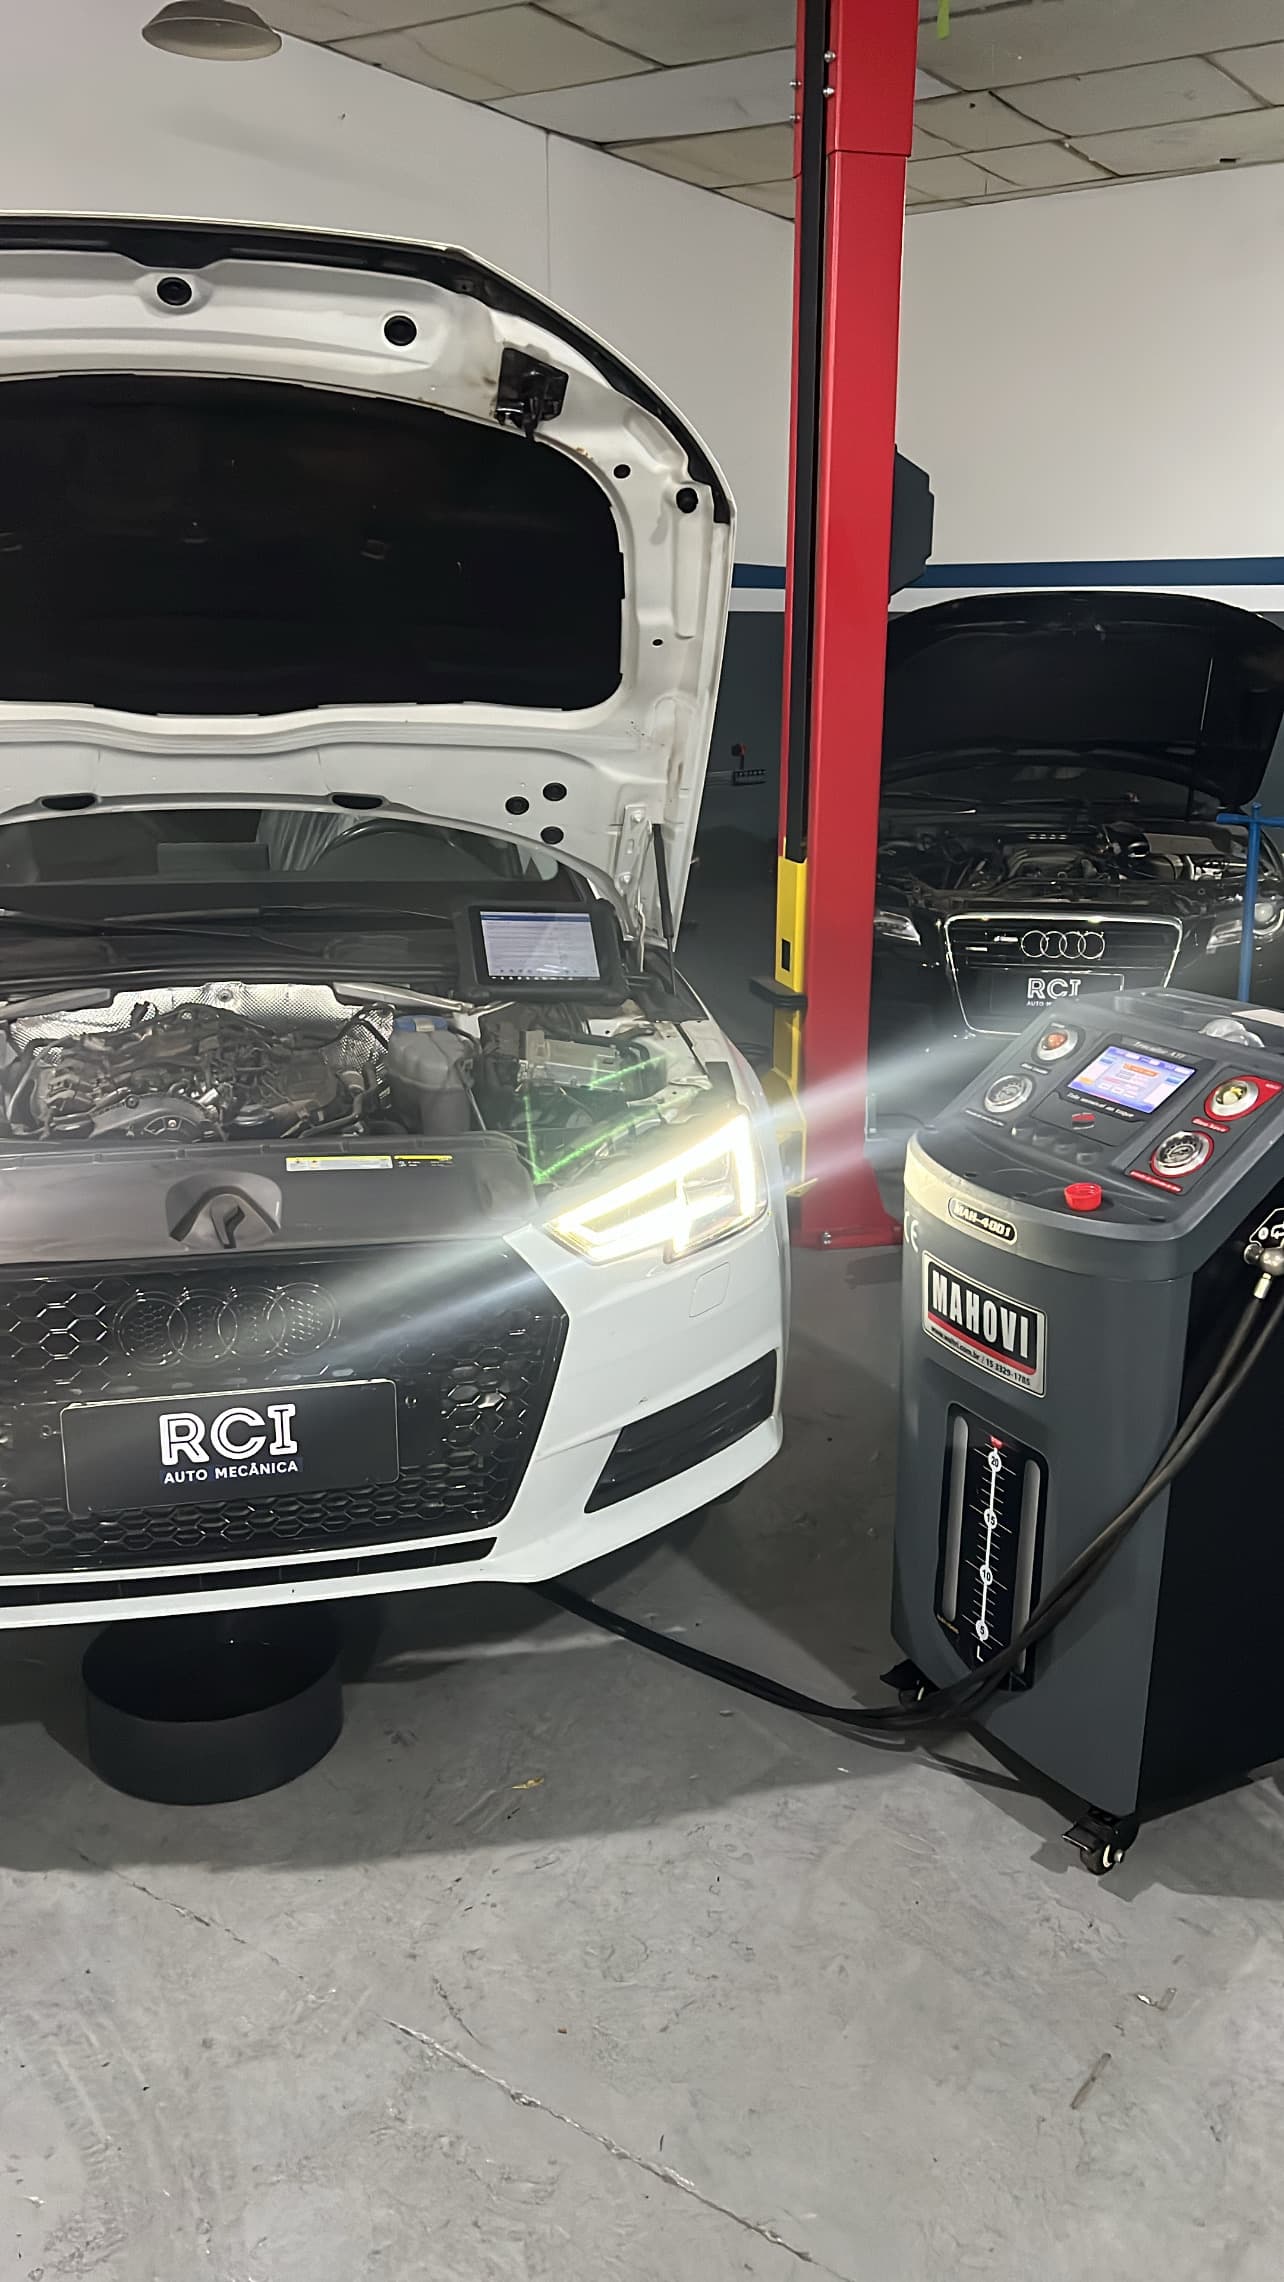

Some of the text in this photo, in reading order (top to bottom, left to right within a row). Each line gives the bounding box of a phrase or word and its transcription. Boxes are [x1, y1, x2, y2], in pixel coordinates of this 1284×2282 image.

[1027, 977, 1081, 999] RCI
[953, 1200, 1011, 1238] MAH-4001
[932, 1269, 1029, 1359] MAHOVI
[159, 1403, 298, 1466] RCI
[164, 1460, 299, 1485] AUTO MECÂNICA
[991, 1455, 999, 1468] 20
[986, 1513, 995, 1528] 15
[982, 1569, 991, 1581] 10
